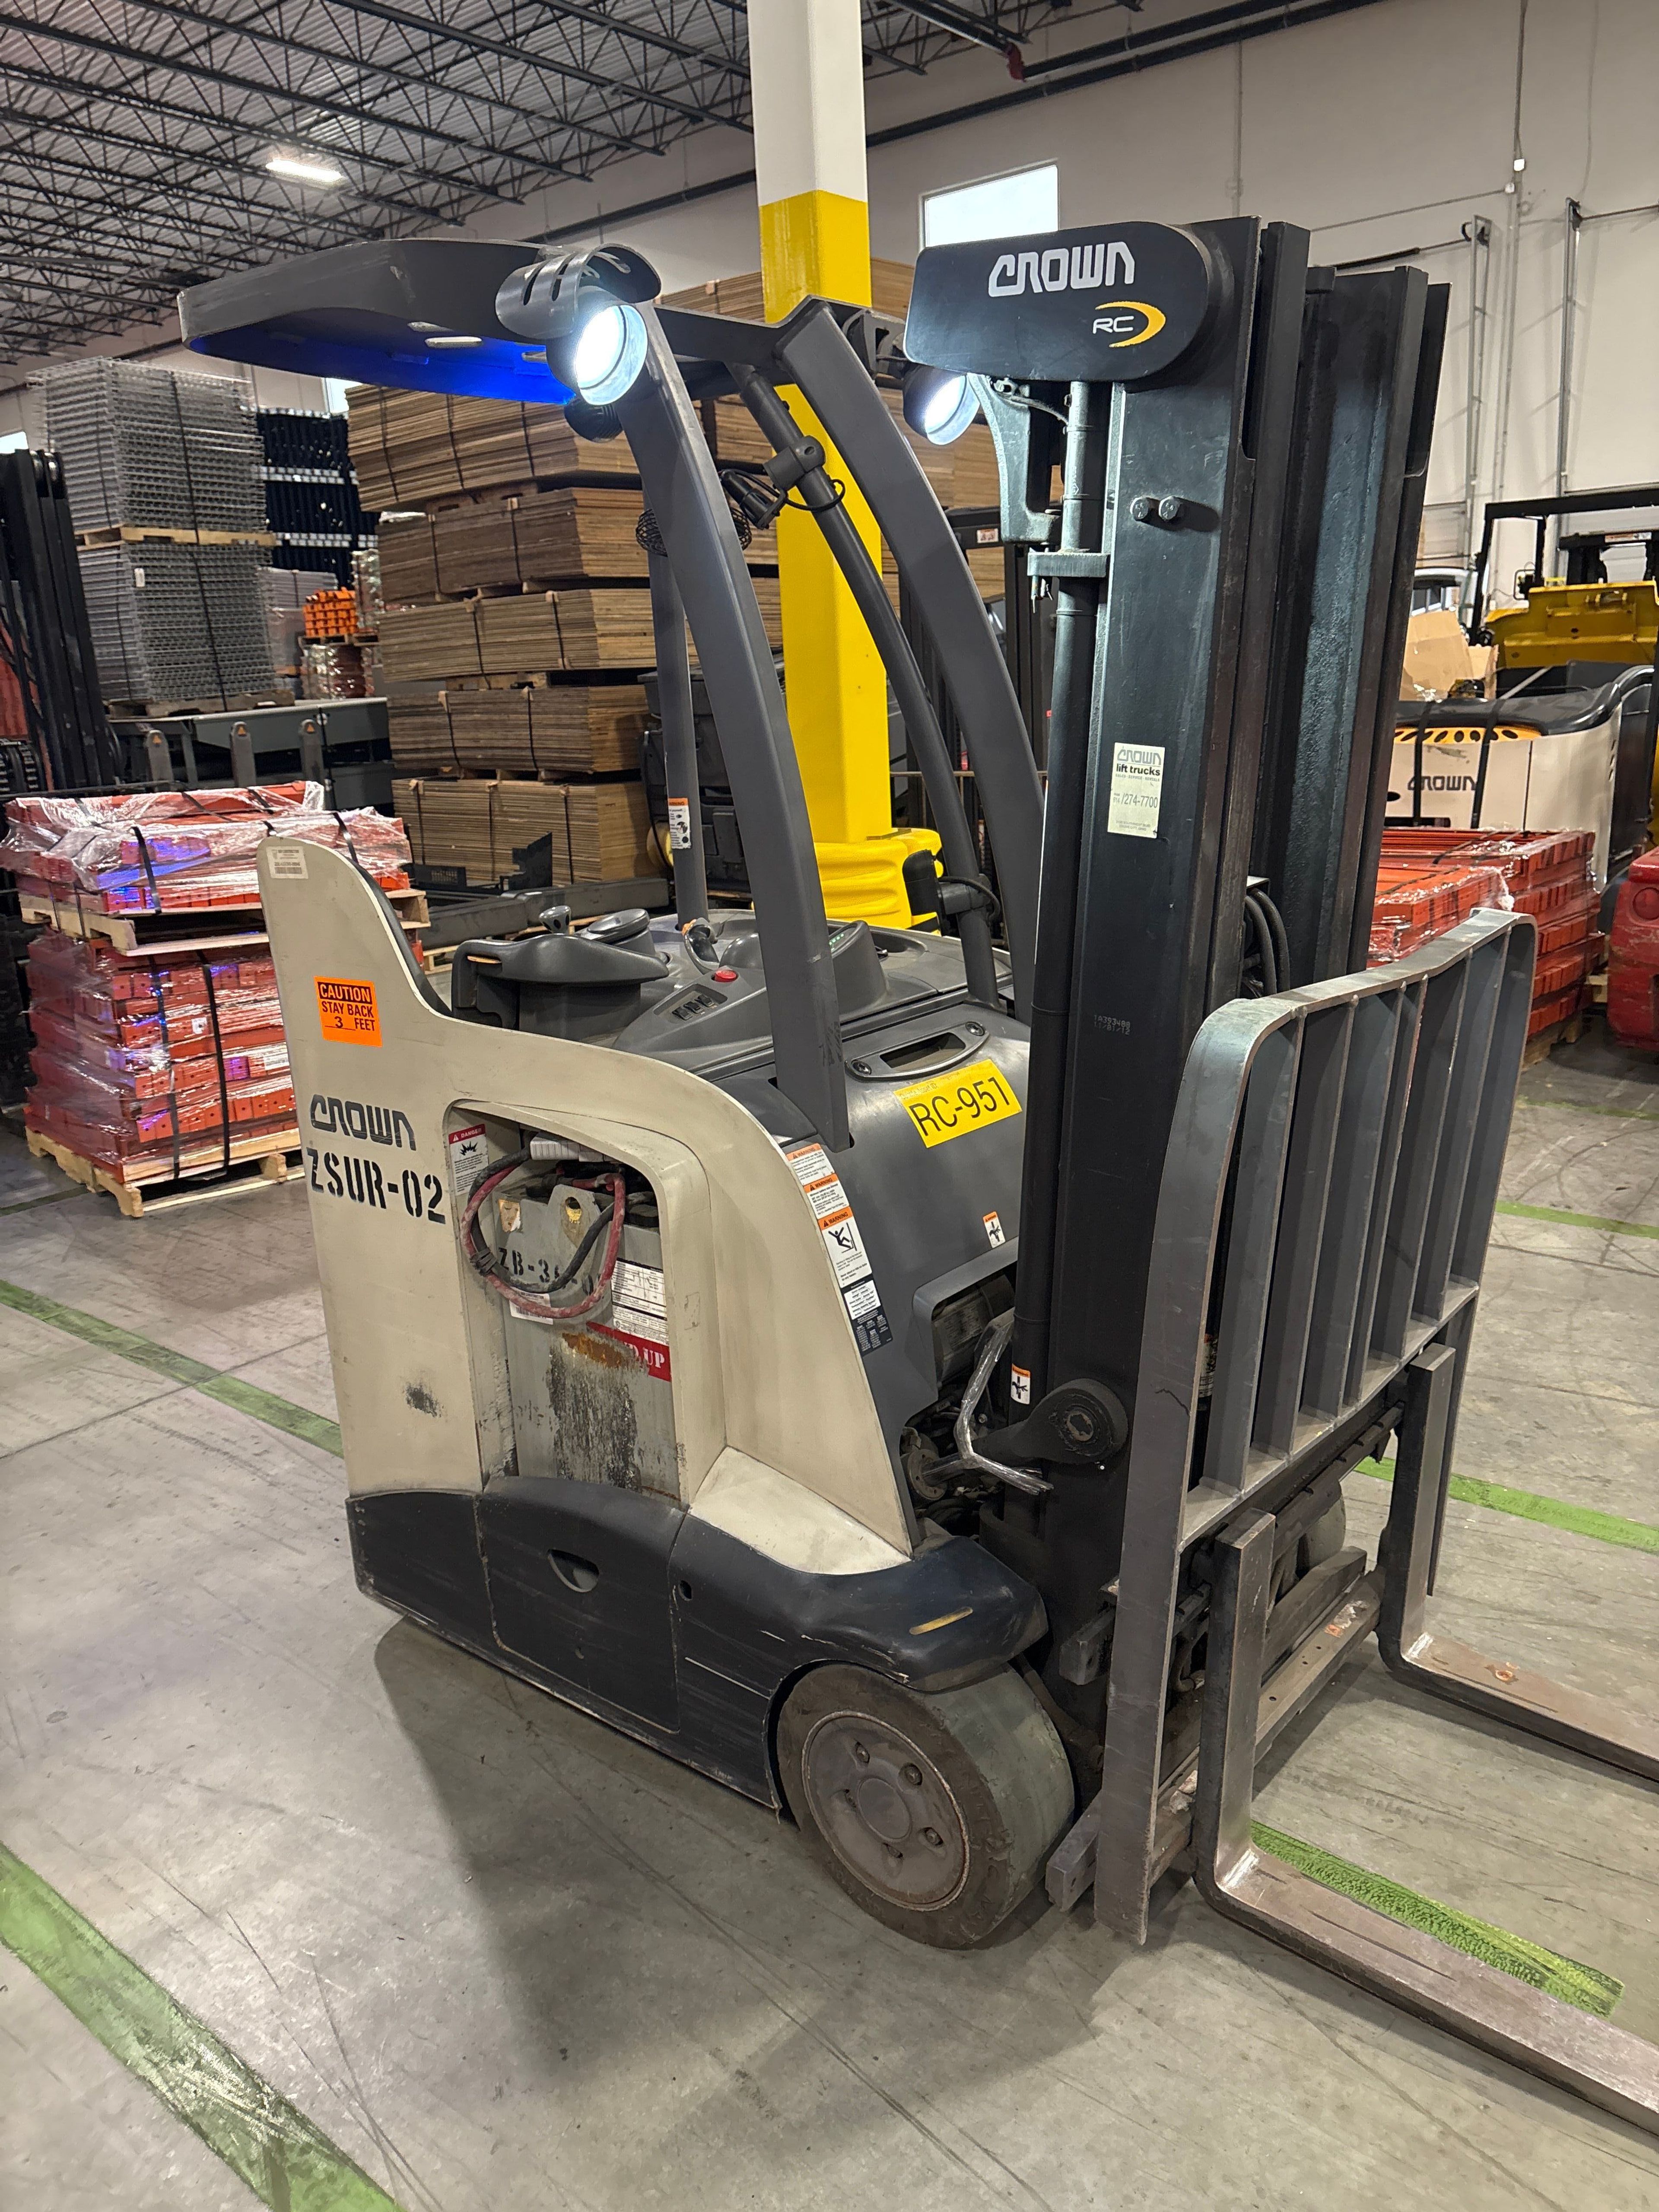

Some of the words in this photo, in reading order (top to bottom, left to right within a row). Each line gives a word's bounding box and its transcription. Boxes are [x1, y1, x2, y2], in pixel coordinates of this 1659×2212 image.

[988, 242, 1135, 297] CROWN
[1092, 316, 1135, 334] RC
[1117, 749, 1161, 765] CROWN
[1116, 763, 1127, 772] lift
[1130, 766, 1160, 776] trucks
[320, 984, 371, 1002] CAUTION
[322, 1001, 344, 1015] STAY
[347, 1004, 374, 1018] BACK
[335, 1016, 344, 1029] 3
[355, 1018, 375, 1032] FEET
[909, 1077, 1010, 1137] RC-951
[310, 1094, 416, 1151] CROWN
[461, 1128, 482, 1138] DANGER
[306, 1147, 446, 1224] ZSUR-02
[815, 1178, 833, 1189] WARNING
[828, 1212, 849, 1224] WARNING
[643, 1347, 665, 1369] UP
